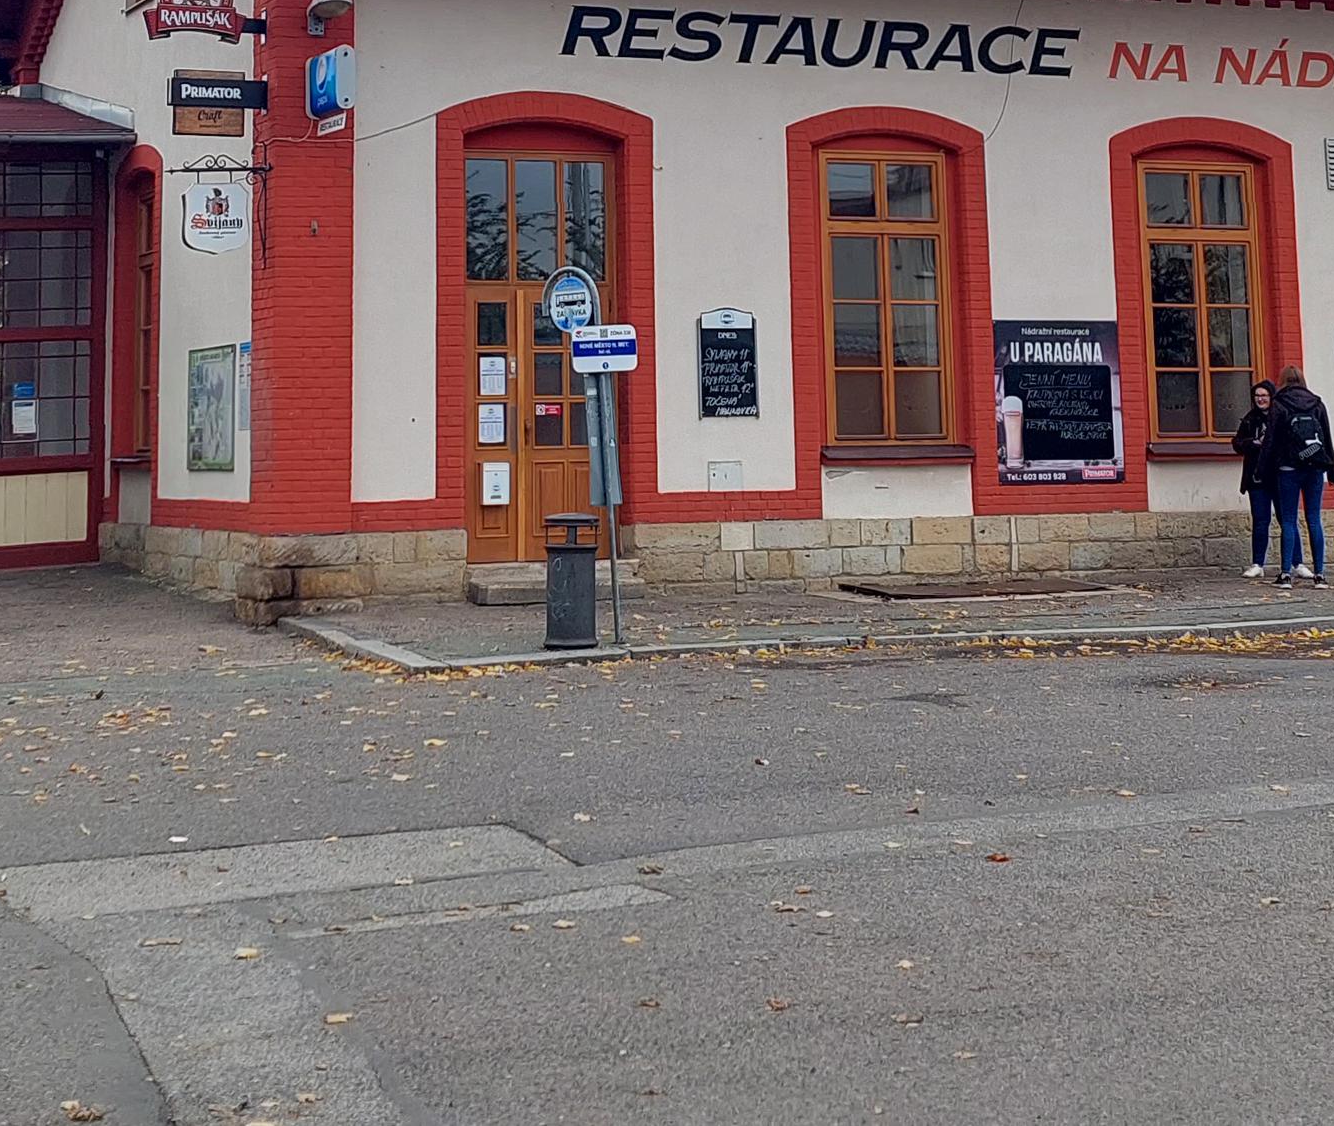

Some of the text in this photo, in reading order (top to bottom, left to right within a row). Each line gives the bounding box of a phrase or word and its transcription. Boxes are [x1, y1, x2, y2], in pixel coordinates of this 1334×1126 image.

[161, 9, 232, 28] RAMPUŠÁK
[559, 5, 1081, 78] RESTAURACE
[1107, 41, 1188, 82] NA
[181, 83, 242, 99] PRIMATOR
[197, 110, 223, 123] Craft
[190, 213, 243, 229] Svijany
[1021, 327, 1053, 335] Nádražní
[1010, 337, 1103, 363] U PARAGÁNA
